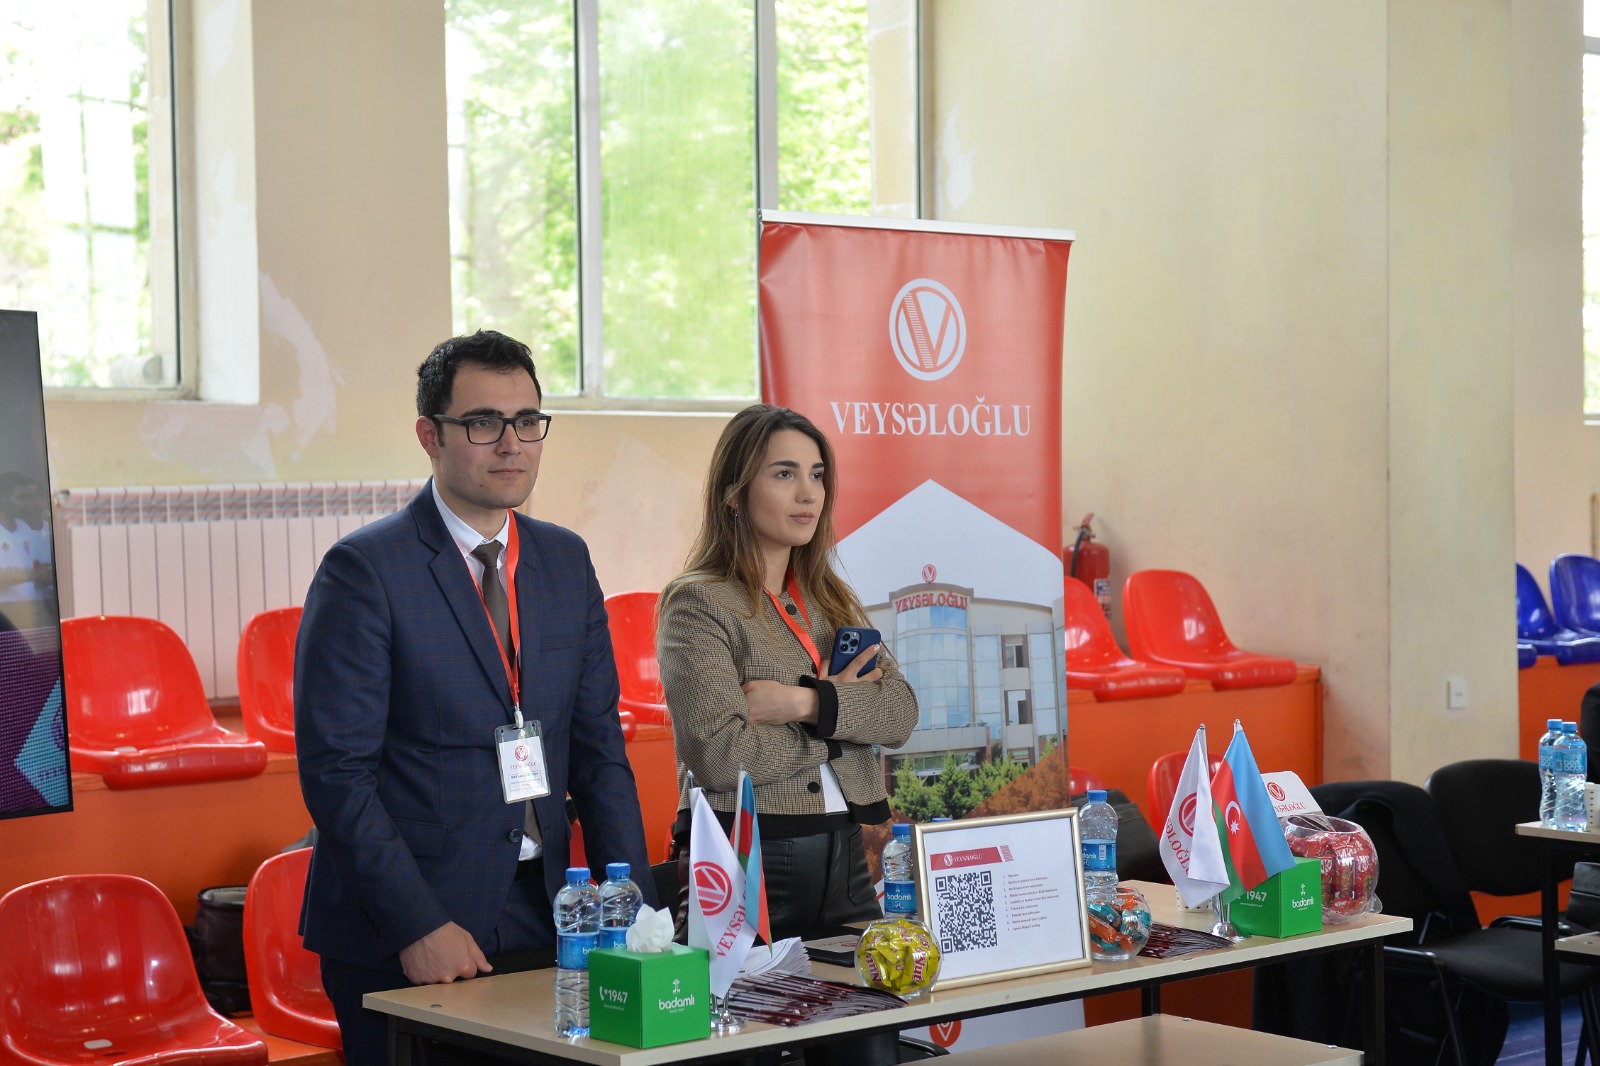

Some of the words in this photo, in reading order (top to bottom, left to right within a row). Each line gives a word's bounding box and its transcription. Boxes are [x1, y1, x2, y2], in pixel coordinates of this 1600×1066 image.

[829, 395, 1031, 436] VEYSƏLOĞLU
[895, 590, 968, 612] VEYSƏLOĞLU
[658, 994, 695, 1010] badamlı
